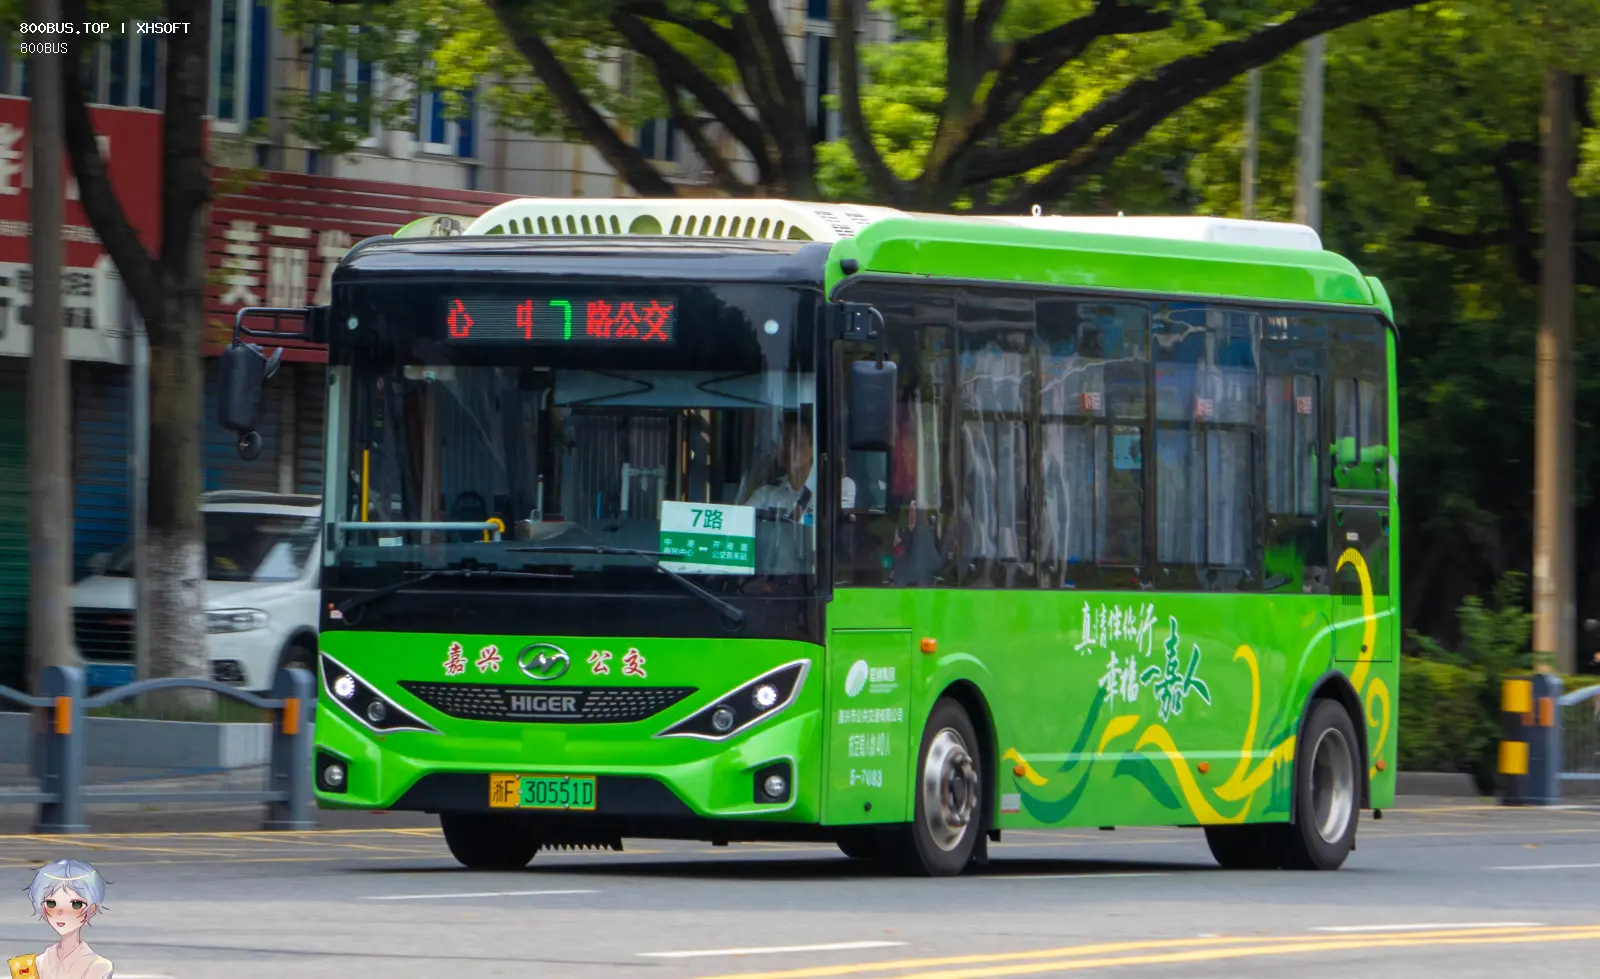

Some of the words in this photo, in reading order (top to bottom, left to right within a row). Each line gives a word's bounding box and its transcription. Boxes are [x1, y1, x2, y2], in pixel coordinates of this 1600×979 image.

[691, 508, 723, 530] 7路
[442, 640, 503, 677] 嘉兴
[586, 647, 648, 678] 公交
[511, 695, 577, 712] HIGER
